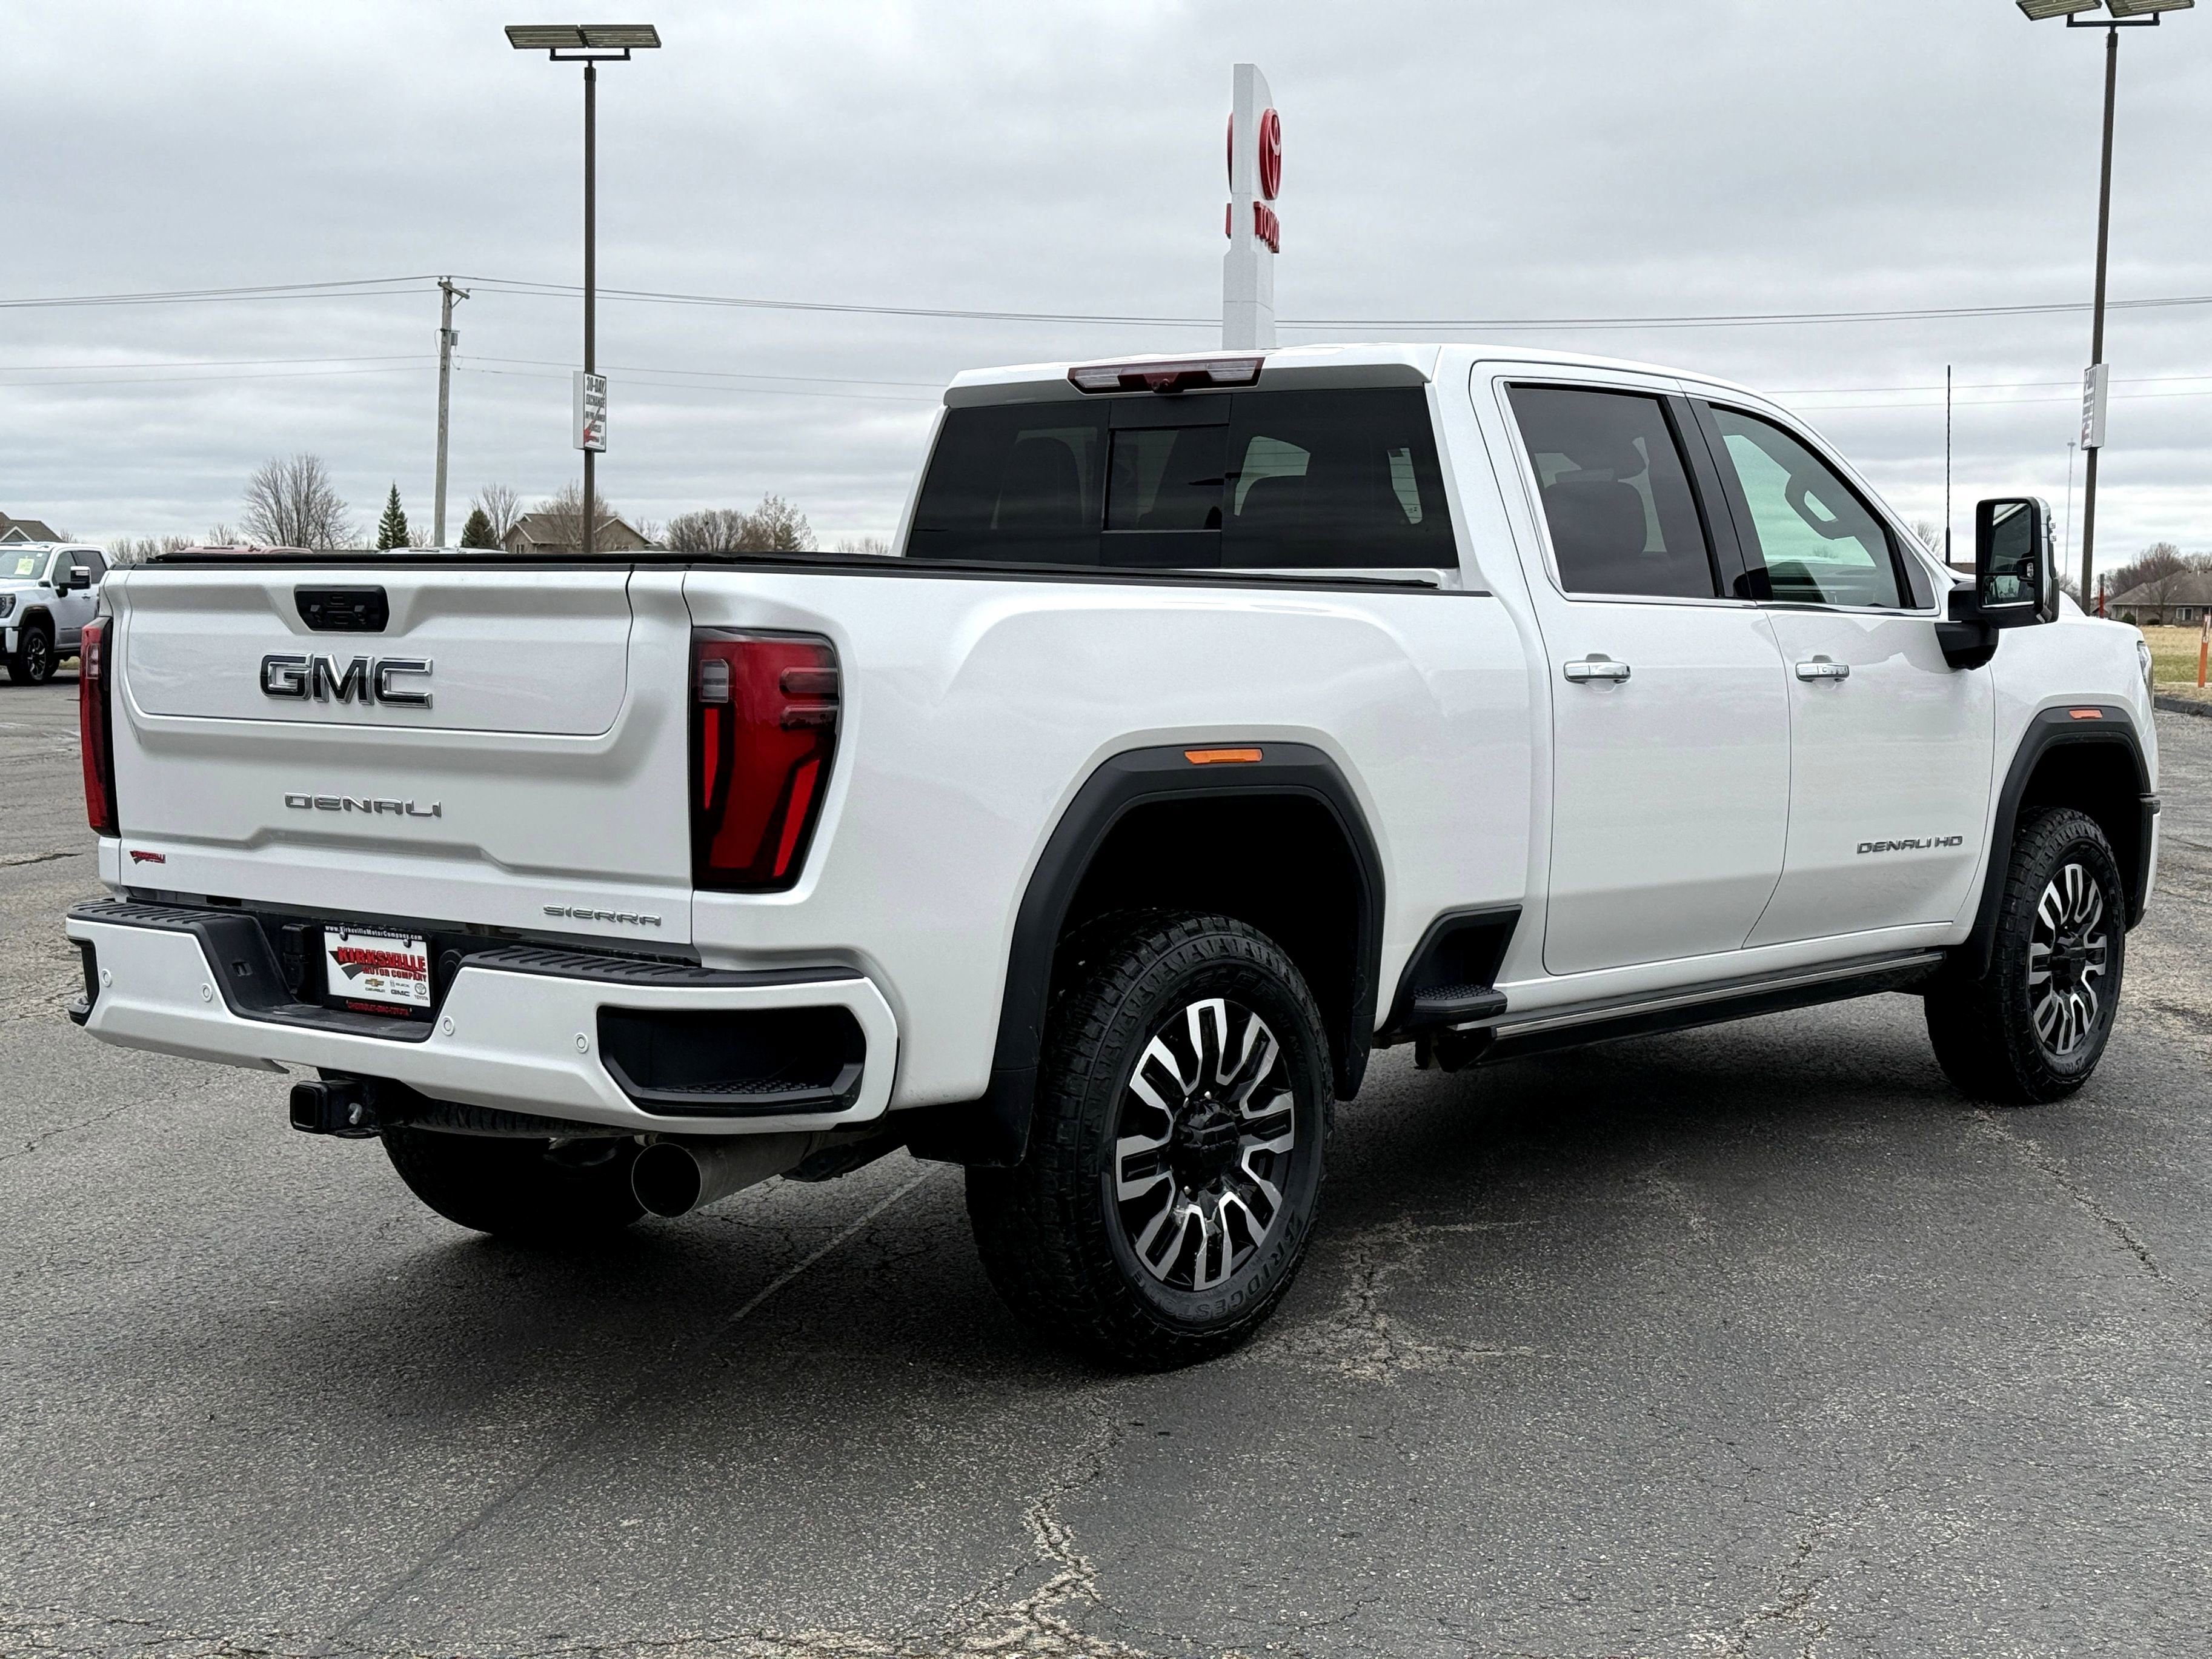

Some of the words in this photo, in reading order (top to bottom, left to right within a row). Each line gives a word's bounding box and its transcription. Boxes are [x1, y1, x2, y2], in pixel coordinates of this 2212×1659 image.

[586, 376, 605, 394] 30-DAY
[260, 653, 433, 709] GMC
[284, 791, 442, 818] DENALI
[1857, 837, 1931, 854] DENALI
[1935, 836, 1963, 848] HD
[543, 903, 662, 926] SIERRA
[337, 946, 427, 973] KIRKSVILLE
[362, 966, 390, 977] MOTOR
[391, 969, 427, 982] COMPANY
